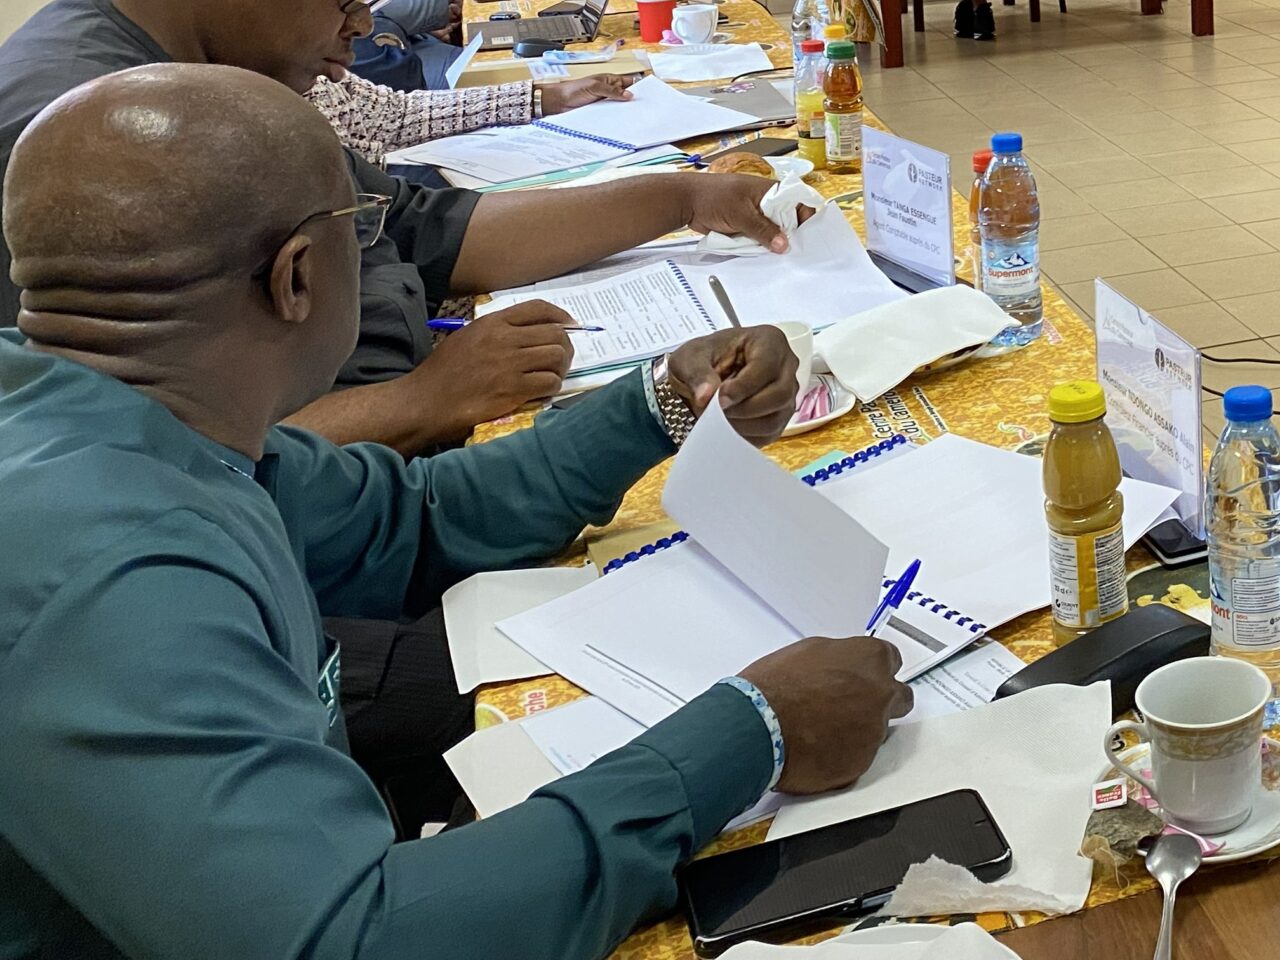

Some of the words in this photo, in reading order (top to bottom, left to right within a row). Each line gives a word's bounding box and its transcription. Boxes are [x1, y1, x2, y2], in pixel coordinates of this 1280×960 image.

[918, 168, 943, 184] PASTEUR
[871, 192, 893, 207] Monsieur
[894, 200, 910, 214] TANGA
[887, 208, 899, 218] Jean
[899, 213, 917, 227] Faustin
[988, 266, 1034, 279] Supermont
[1165, 356, 1192, 381] PASTEUR
[1102, 368, 1127, 396] Monsieur
[1127, 388, 1153, 418] NDONGO
[1154, 412, 1179, 439] ASSAKO
